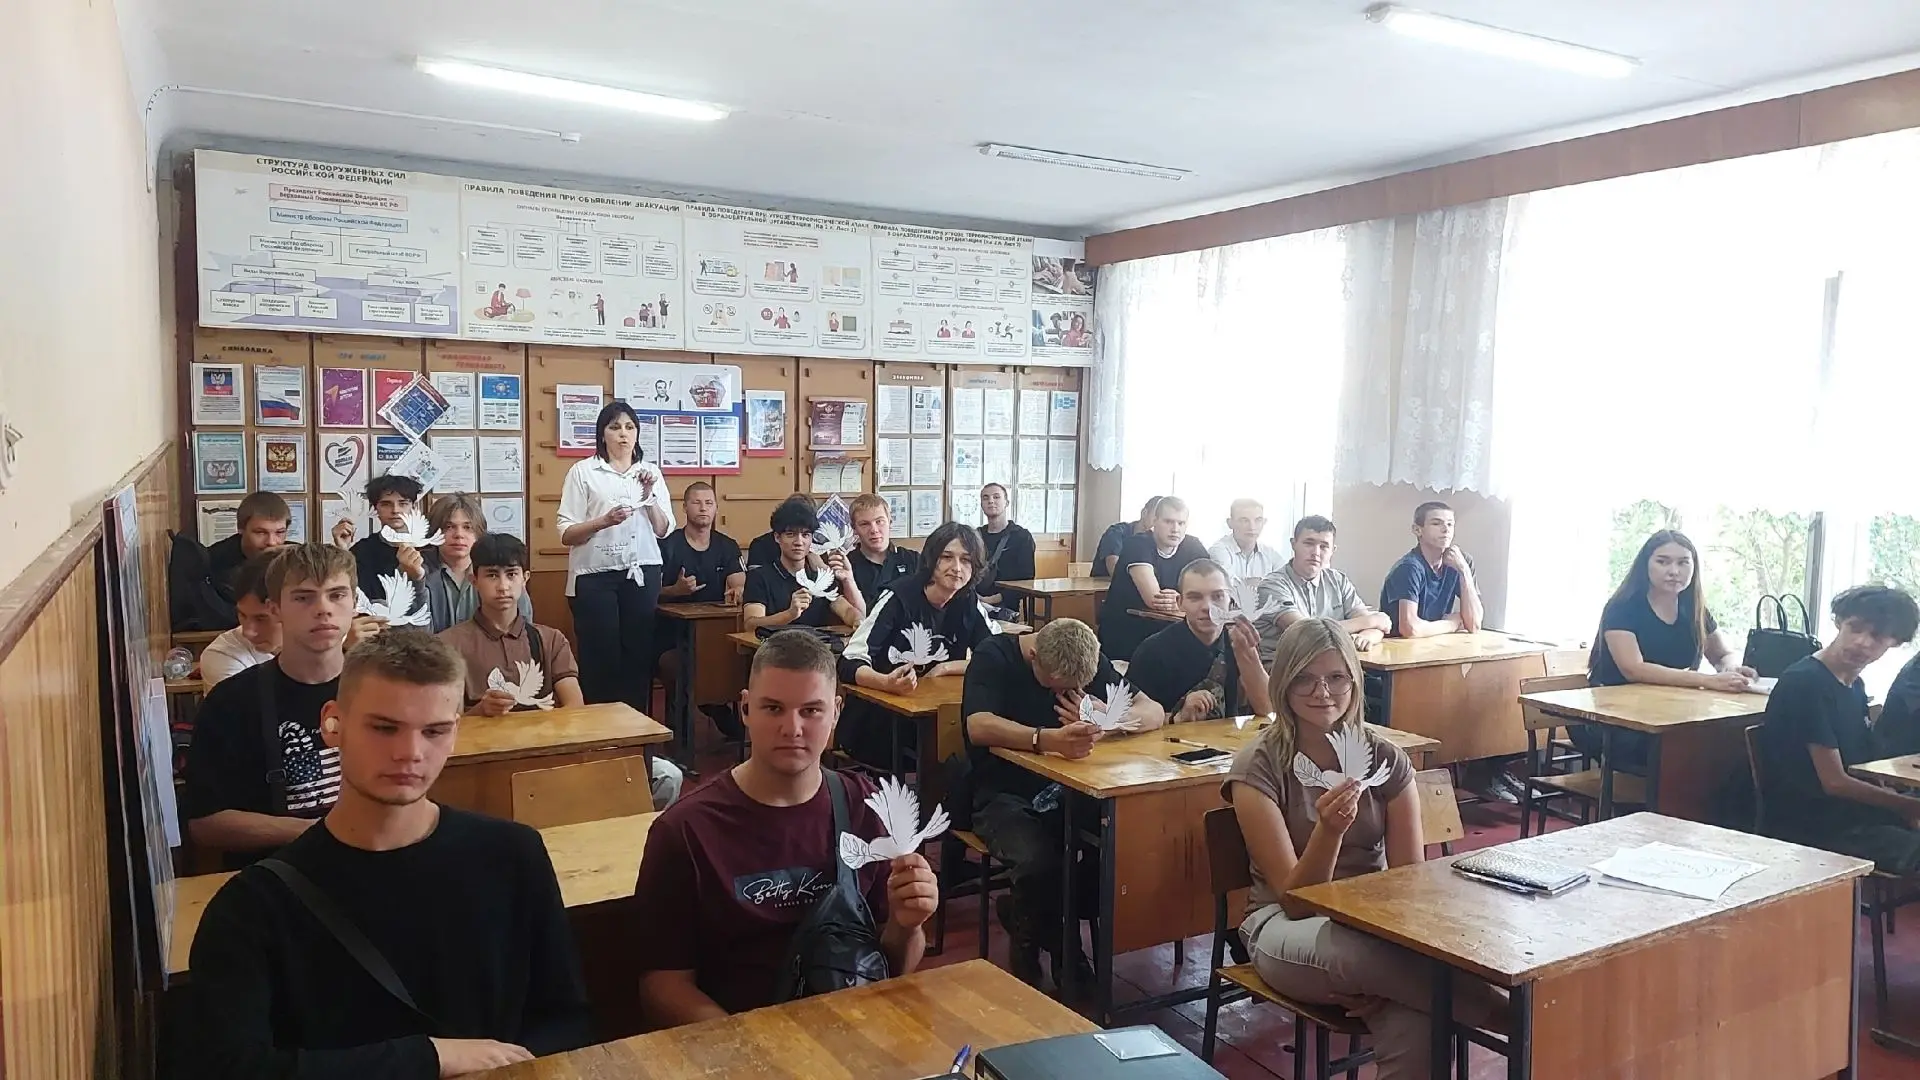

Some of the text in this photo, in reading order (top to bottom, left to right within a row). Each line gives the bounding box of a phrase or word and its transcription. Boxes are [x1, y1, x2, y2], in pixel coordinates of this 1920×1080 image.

[256, 158, 406, 179] СТРУКТУРА ВООРУЖЕННЫХ СИЛ
[271, 167, 393, 186] РОССИЙСКОЙ ФЕДЕРАЦИИ
[464, 183, 505, 194] ПРАВИЛА
[507, 188, 557, 199] ПОВЕДЕНИЯ
[578, 196, 631, 207] ОБЪЯВЛЕНИИ
[635, 202, 680, 212] ЭВАКУАЦИИ
[686, 204, 715, 212] ПРАВИЛА
[717, 207, 753, 216] ПОВЕДЕНИЯ
[769, 212, 791, 220] УГРОЗЕ
[792, 215, 849, 226] ТЕРРОРИСТИЧЕСКОЙ
[708, 212, 766, 223] ОБРАЗОВАТЕЛЬНОЙ
[873, 224, 898, 232] ПРАВИЛА
[222, 345, 274, 354] СИМВОЛИКА
[743, 878, 793, 904] Betty
